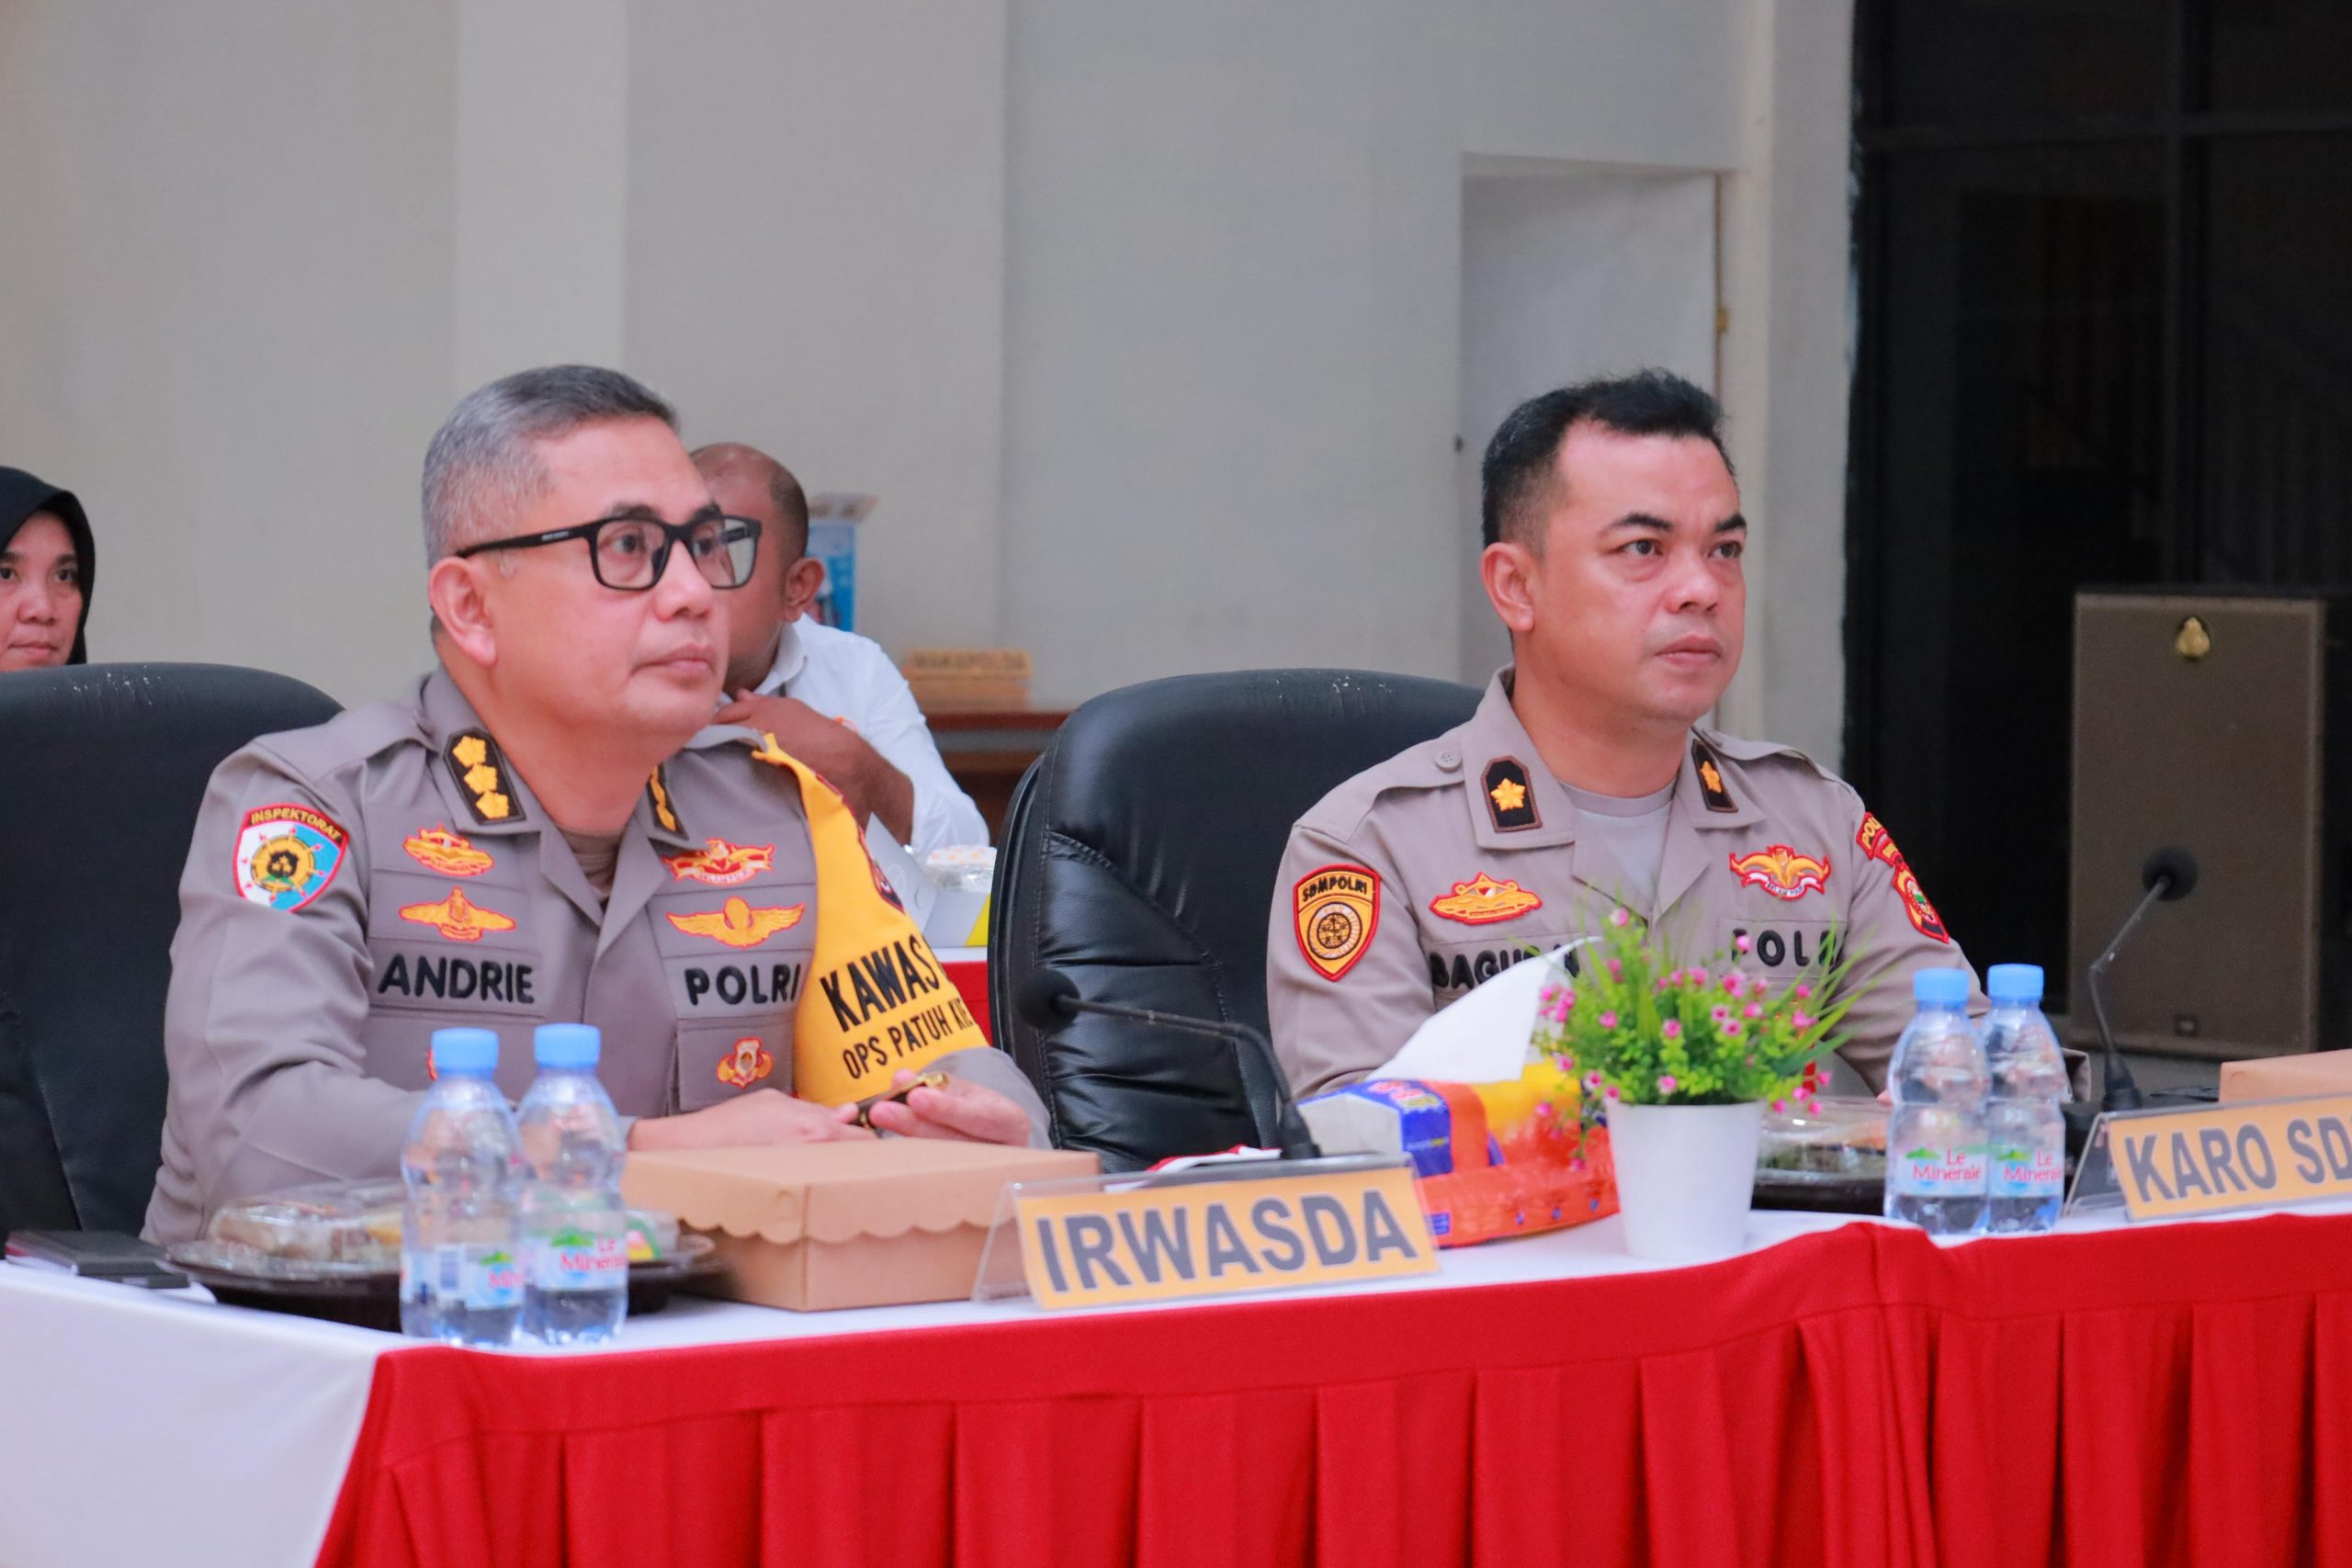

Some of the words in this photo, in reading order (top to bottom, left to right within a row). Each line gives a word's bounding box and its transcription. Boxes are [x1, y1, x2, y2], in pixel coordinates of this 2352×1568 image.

[251, 807, 342, 840] INSPEKTORAT
[378, 953, 535, 1004] ANDRIE
[684, 963, 801, 1006] POLRI
[842, 1035, 888, 1079] OPS
[887, 1004, 954, 1058] PATUH
[1947, 1148, 1966, 1166] Le
[2037, 1148, 2052, 1167] Le
[2124, 1122, 2278, 1203] KARO
[1036, 1189, 1419, 1293] IRWASDA
